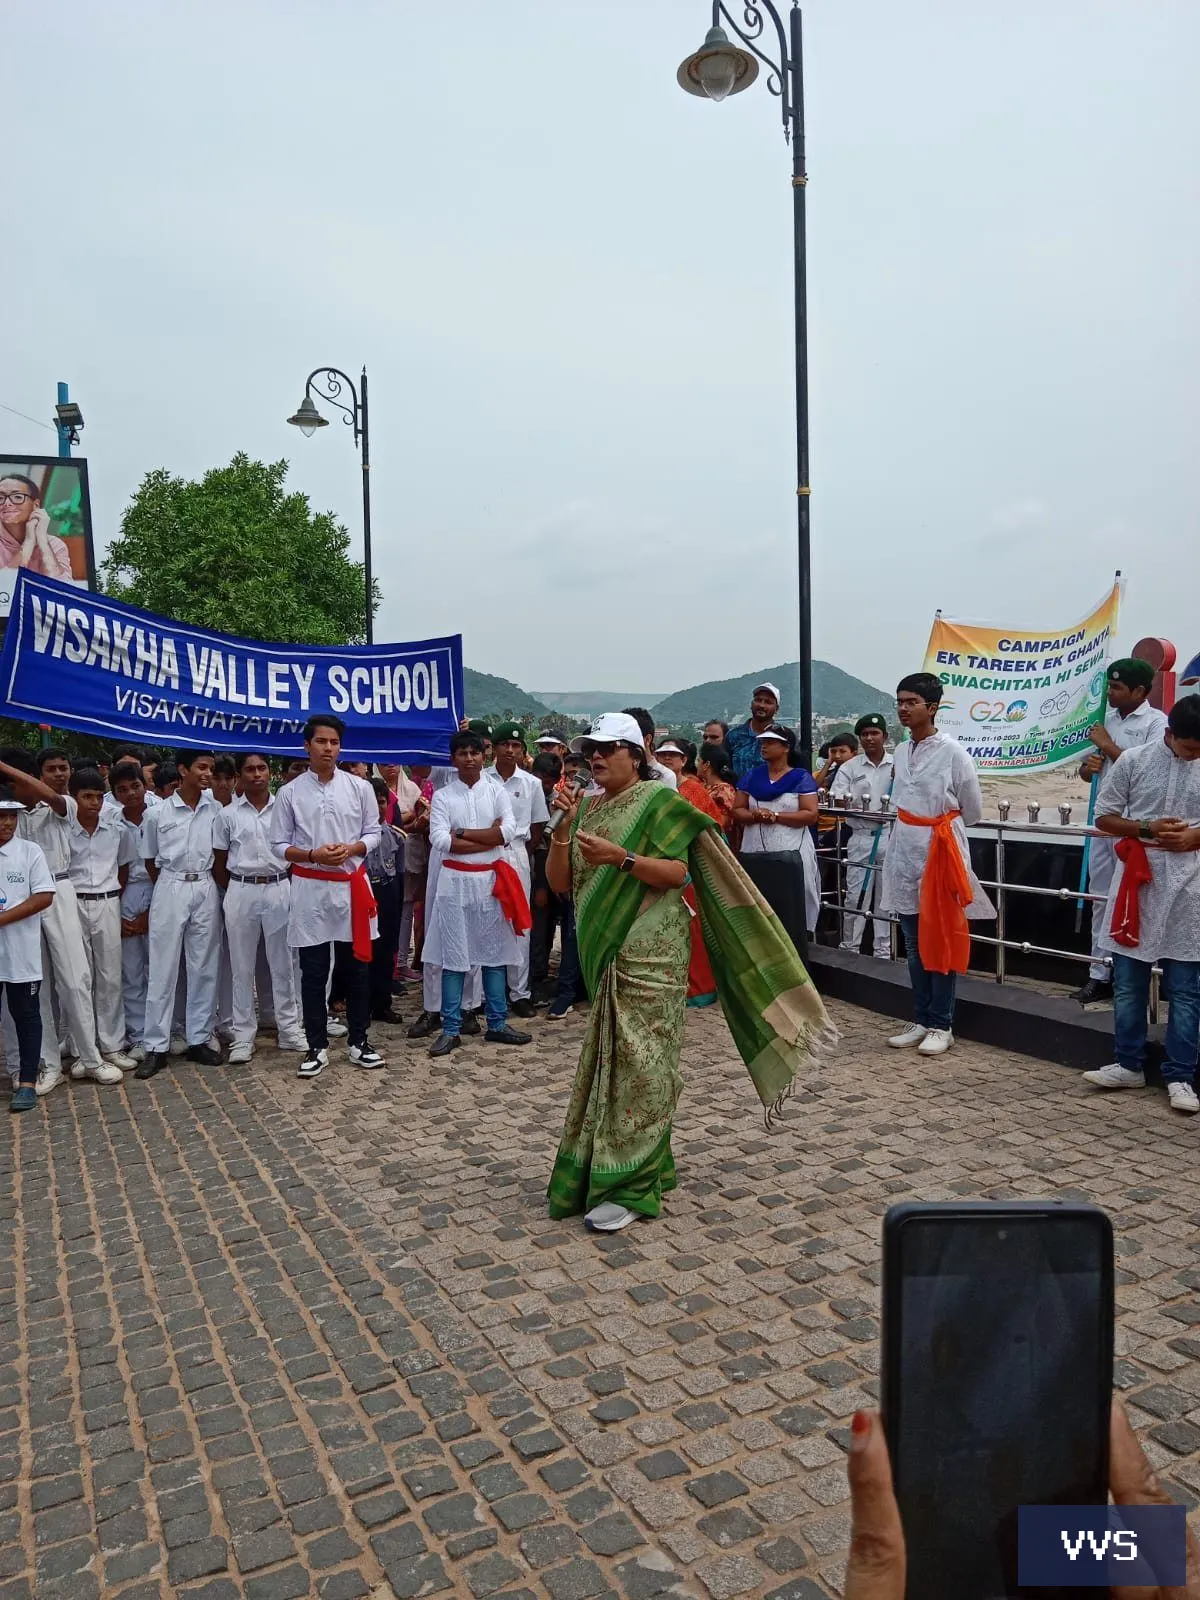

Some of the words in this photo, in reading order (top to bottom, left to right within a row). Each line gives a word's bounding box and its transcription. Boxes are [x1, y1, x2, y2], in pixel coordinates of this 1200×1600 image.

[31, 594, 180, 690] VISAKHA
[186, 643, 316, 711] VALLEY
[328, 659, 449, 715] SCHOOL
[936, 651, 961, 667] EK
[967, 655, 1039, 673] TAREEK
[1042, 655, 1065, 670] EK
[1067, 625, 1111, 662] GHANTA
[998, 629, 1086, 654] CAMPAIGN
[938, 672, 1052, 691] SWACHITATA
[1055, 672, 1071, 684] HI
[1074, 650, 1105, 677] SEWA
[979, 755, 1047, 767] VISAKHAPATNAM
[1009, 738, 1058, 757] VALLEY
